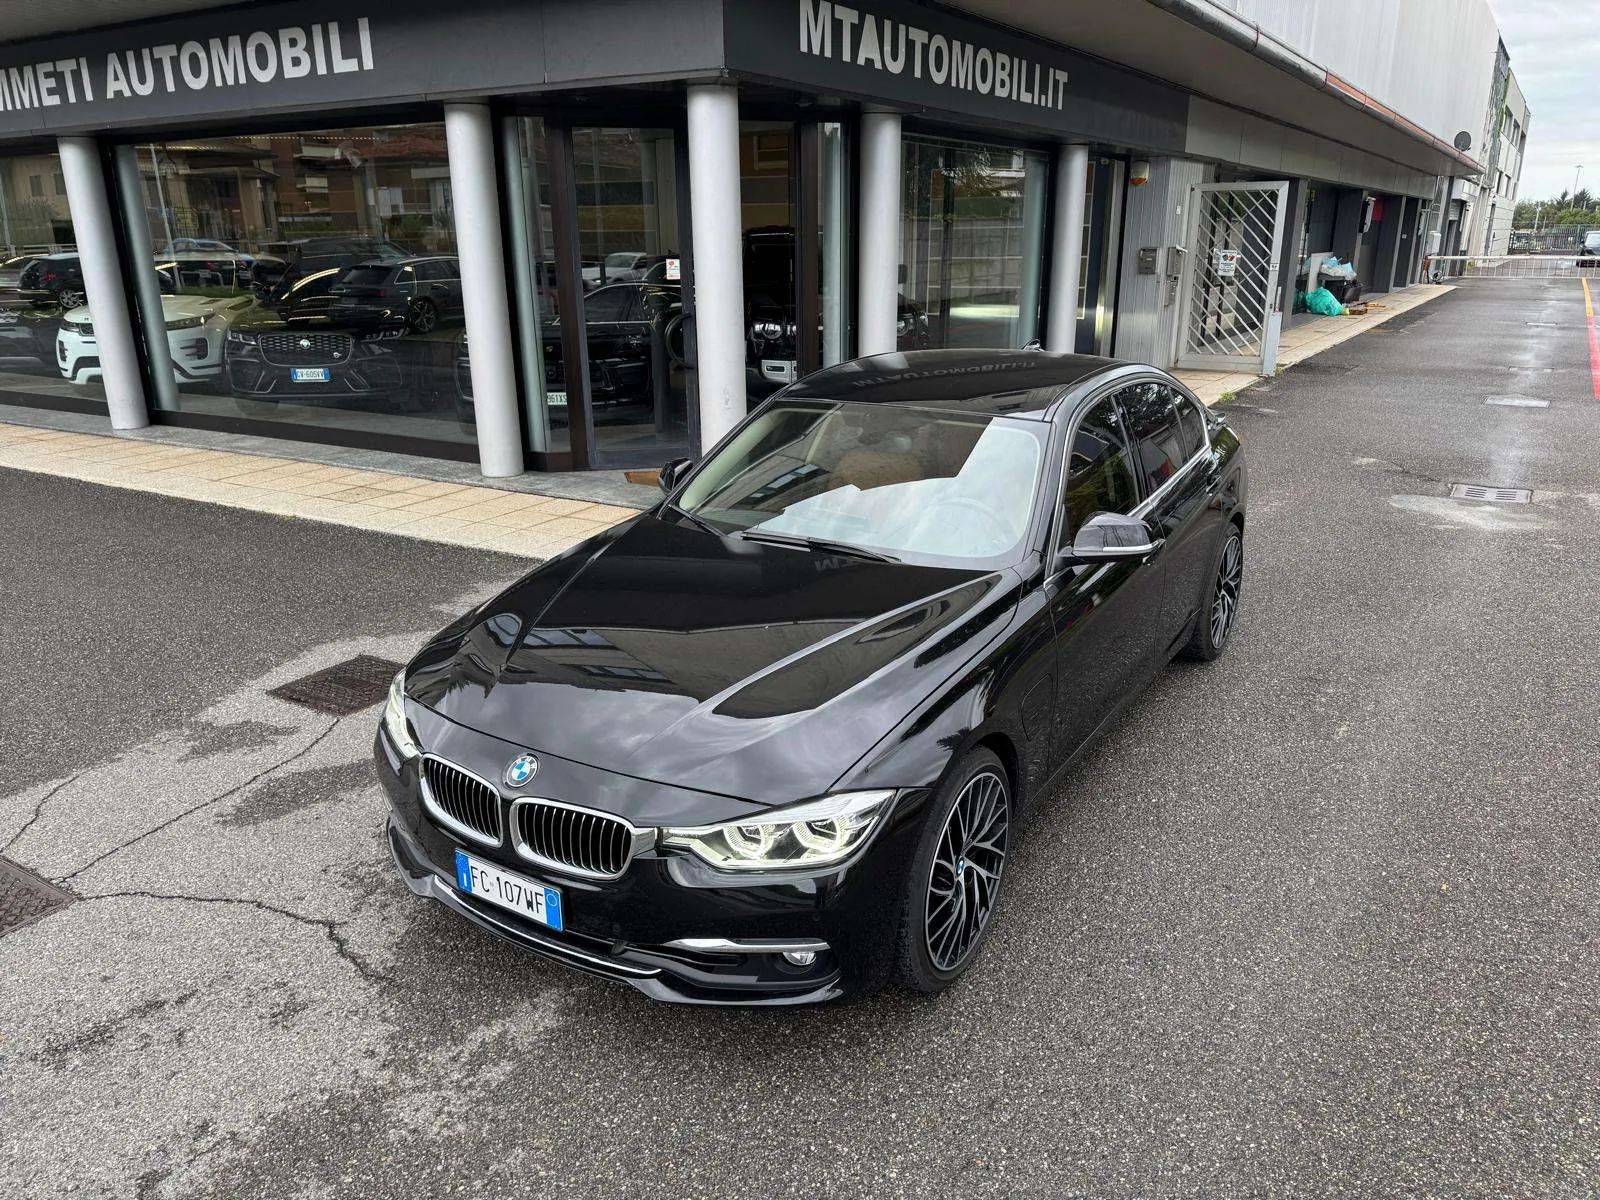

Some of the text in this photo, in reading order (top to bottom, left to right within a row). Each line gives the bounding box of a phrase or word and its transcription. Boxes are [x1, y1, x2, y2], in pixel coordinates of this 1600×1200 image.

[106, 17, 375, 99] AUTOMOBILI
[799, 0, 1068, 110] MTAUTOMOBILI.IT
[470, 866, 490, 893] FC
[496, 876, 543, 913] 107WF
